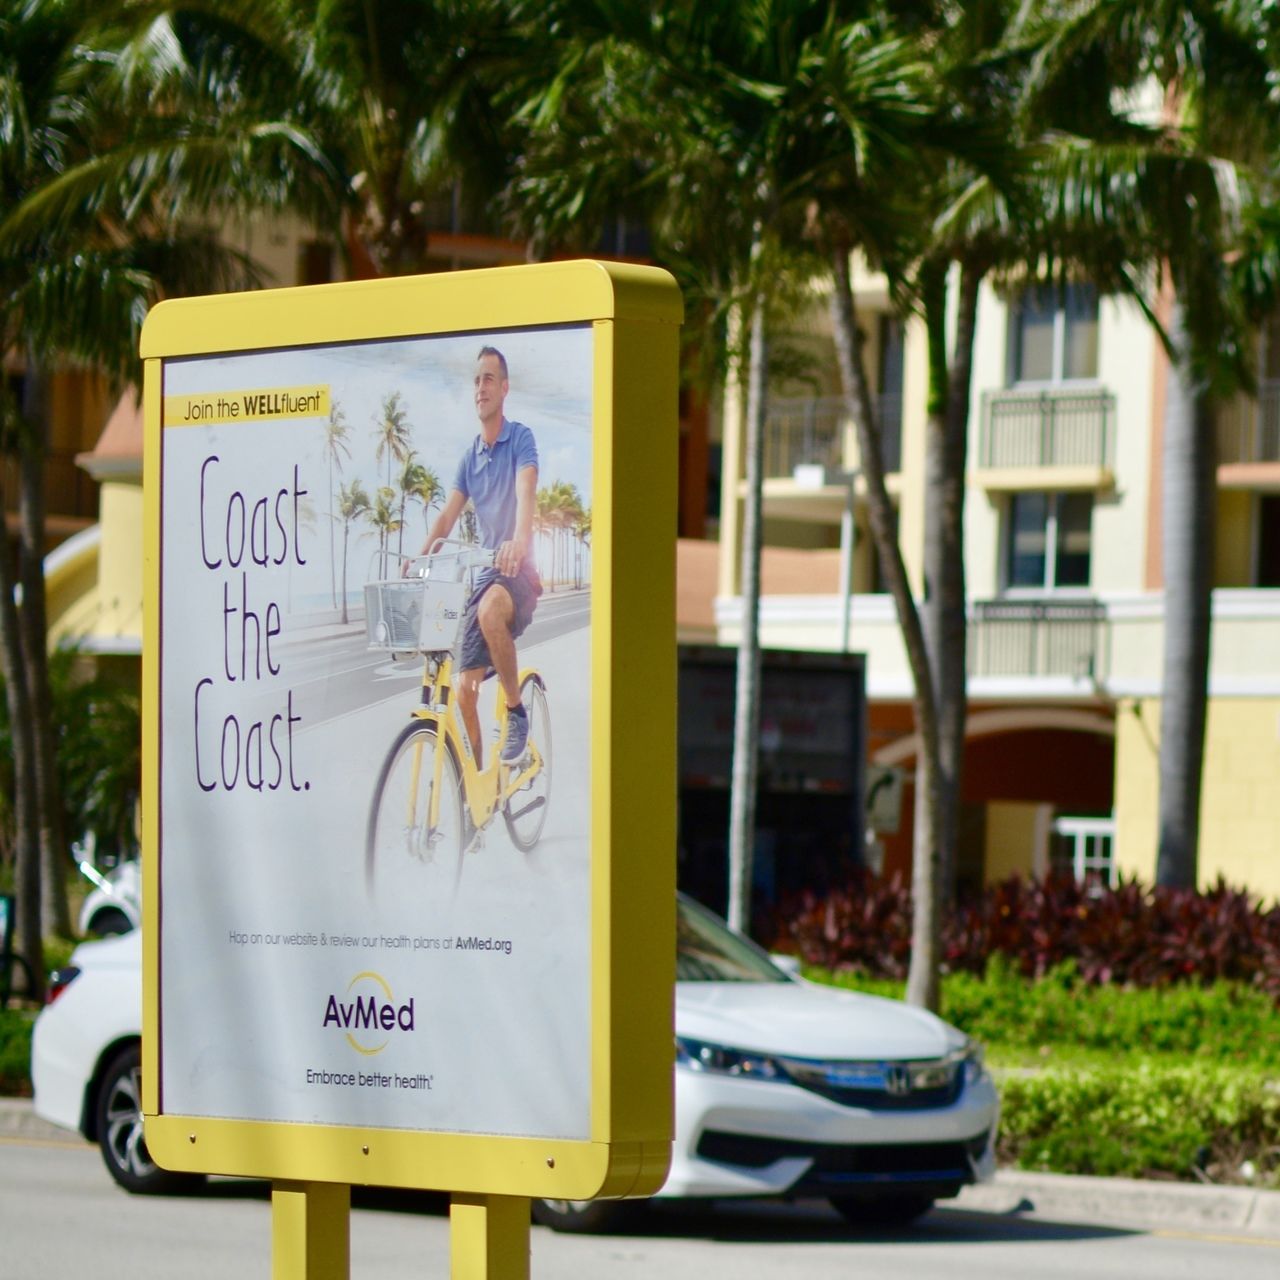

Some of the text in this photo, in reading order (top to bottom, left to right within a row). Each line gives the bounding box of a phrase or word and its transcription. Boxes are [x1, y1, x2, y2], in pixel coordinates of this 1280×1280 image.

[183, 400, 214, 421] Join
[217, 398, 240, 418] the
[199, 454, 309, 570] Coast
[223, 570, 281, 682] the
[193, 676, 311, 792] Coast.
[229, 930, 249, 947] Hop
[250, 933, 262, 945] on
[264, 933, 281, 945] our
[283, 932, 318, 946] website
[319, 932, 328, 946] &
[330, 933, 360, 947] review
[361, 935, 378, 948] our
[380, 934, 411, 949] health
[413, 935, 441, 951] plans
[455, 936, 513, 955] AvMed.org
[322, 994, 415, 1031] AvMed
[306, 1069, 356, 1086] Embrace
[358, 1071, 392, 1088] better
